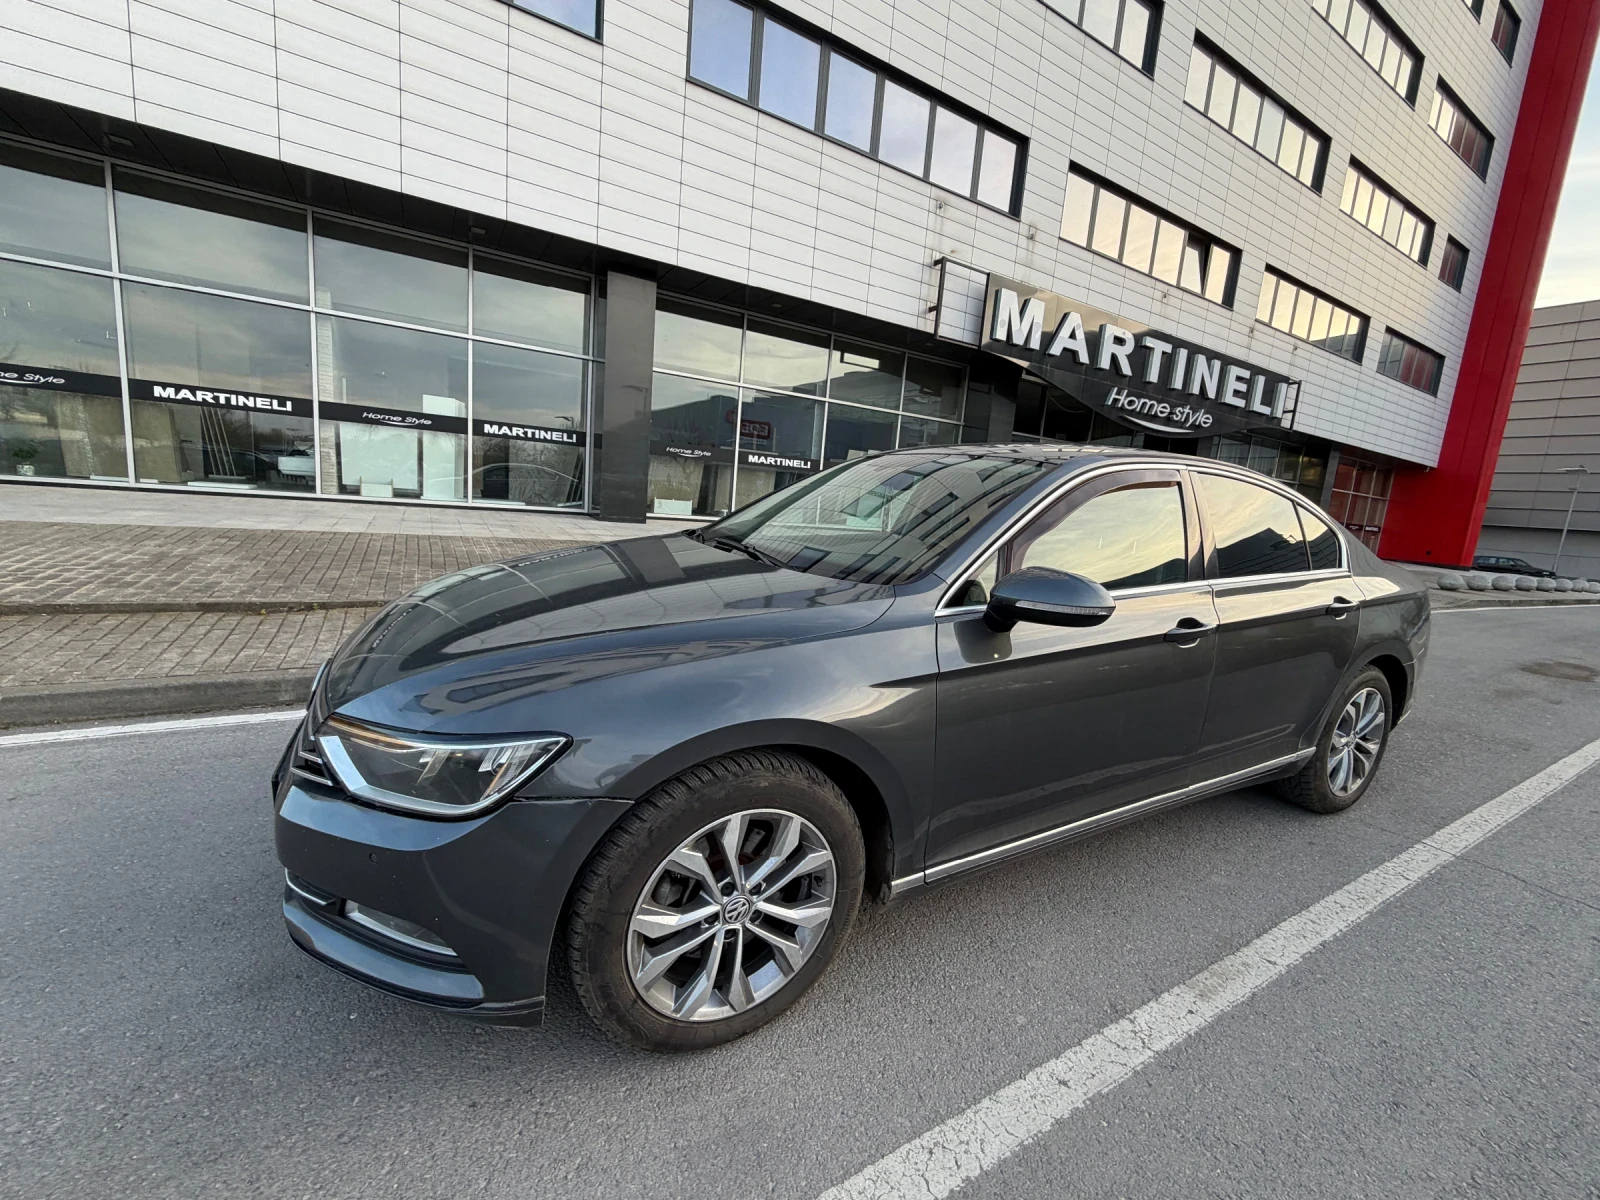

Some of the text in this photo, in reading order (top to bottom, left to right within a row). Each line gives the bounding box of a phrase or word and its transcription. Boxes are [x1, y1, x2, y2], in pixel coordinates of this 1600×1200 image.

[991, 287, 1288, 418] MARTINELI
[23, 373, 65, 384] Style
[153, 386, 292, 412] MARTINELI
[1106, 386, 1213, 428] Home style
[362, 411, 432, 425] Home Style
[483, 423, 577, 443] MARTINELI
[666, 446, 692, 454] Home
[748, 454, 811, 469] MARTINELI
